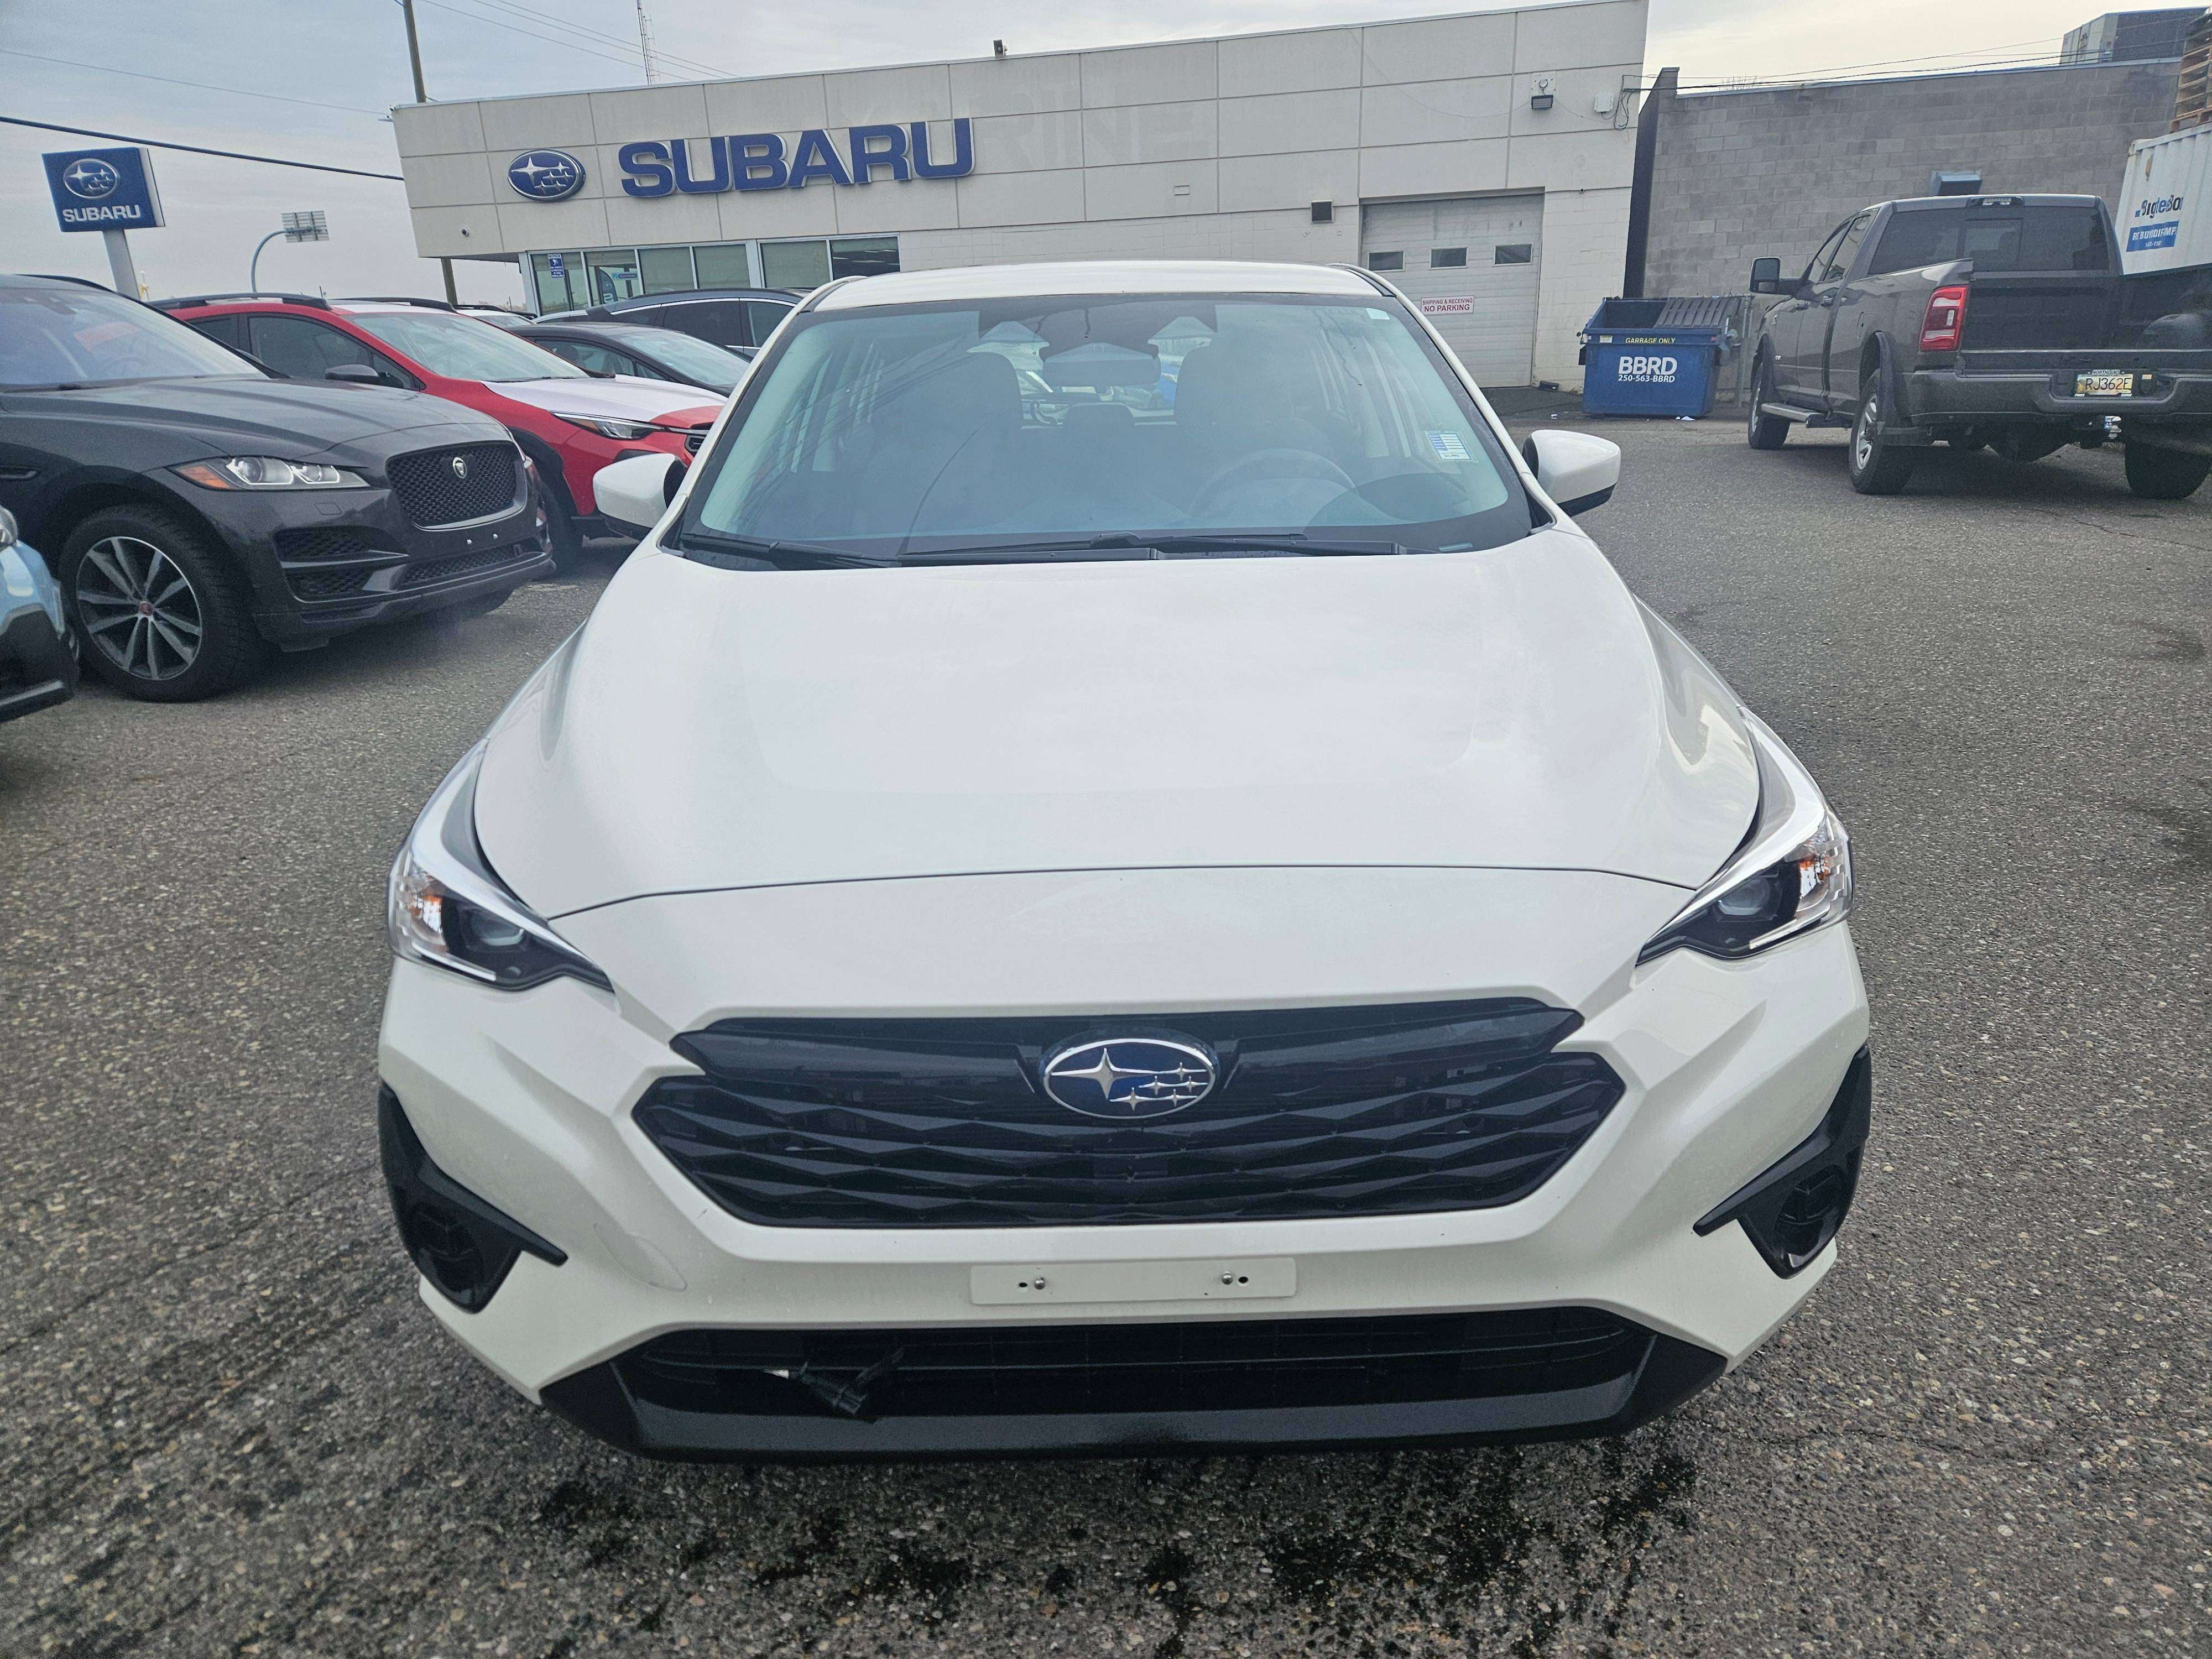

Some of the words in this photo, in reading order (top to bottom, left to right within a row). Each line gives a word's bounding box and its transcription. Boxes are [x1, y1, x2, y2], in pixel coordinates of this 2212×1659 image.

[618, 117, 975, 198] SUBARU
[62, 204, 140, 222] SUBARU
[1618, 356, 1678, 375] BBRD
[1618, 374, 1675, 383] 250-563-BBRD
[2085, 378, 2132, 390] RJ362E
